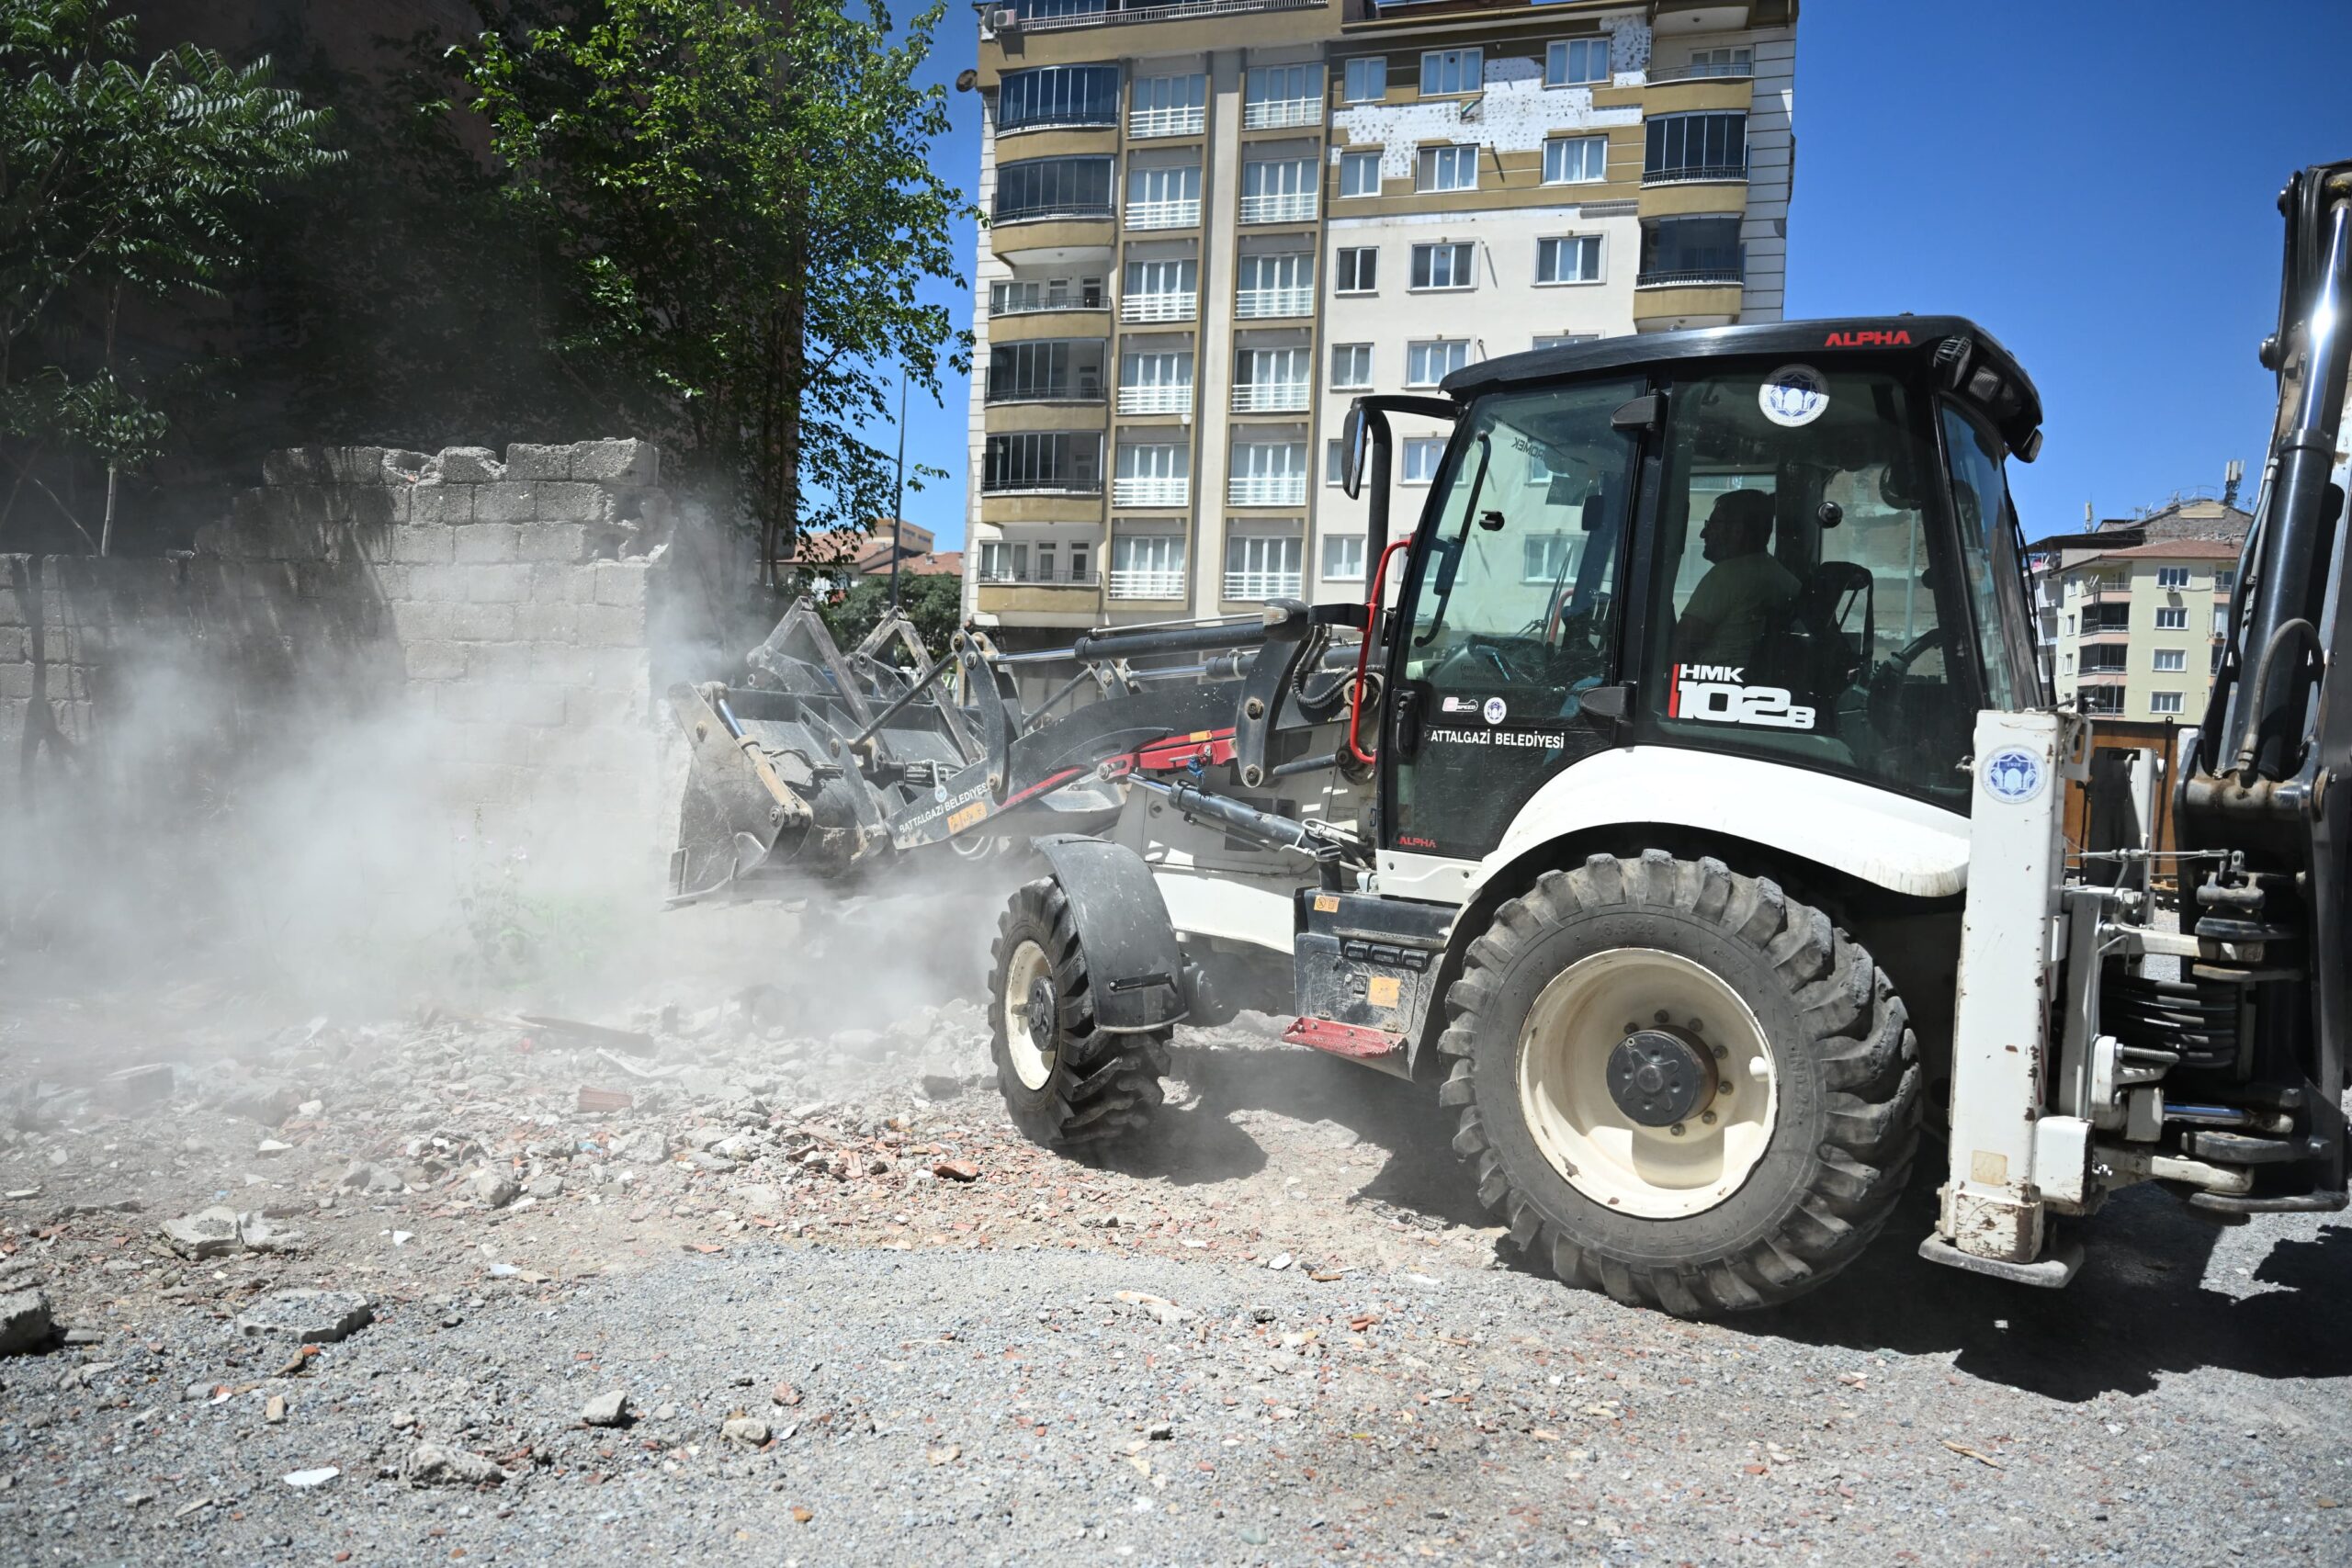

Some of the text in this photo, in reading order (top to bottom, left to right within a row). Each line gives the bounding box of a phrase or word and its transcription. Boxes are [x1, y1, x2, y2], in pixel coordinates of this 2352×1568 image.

[1824, 331, 1911, 346] ALPHA
[1679, 663, 1745, 682] HMK
[1424, 729, 1565, 749] ATTALGAZİ BELEDİYESİ
[944, 783, 988, 811] BELEDİYES
[1398, 836, 1437, 848] ALPHA
